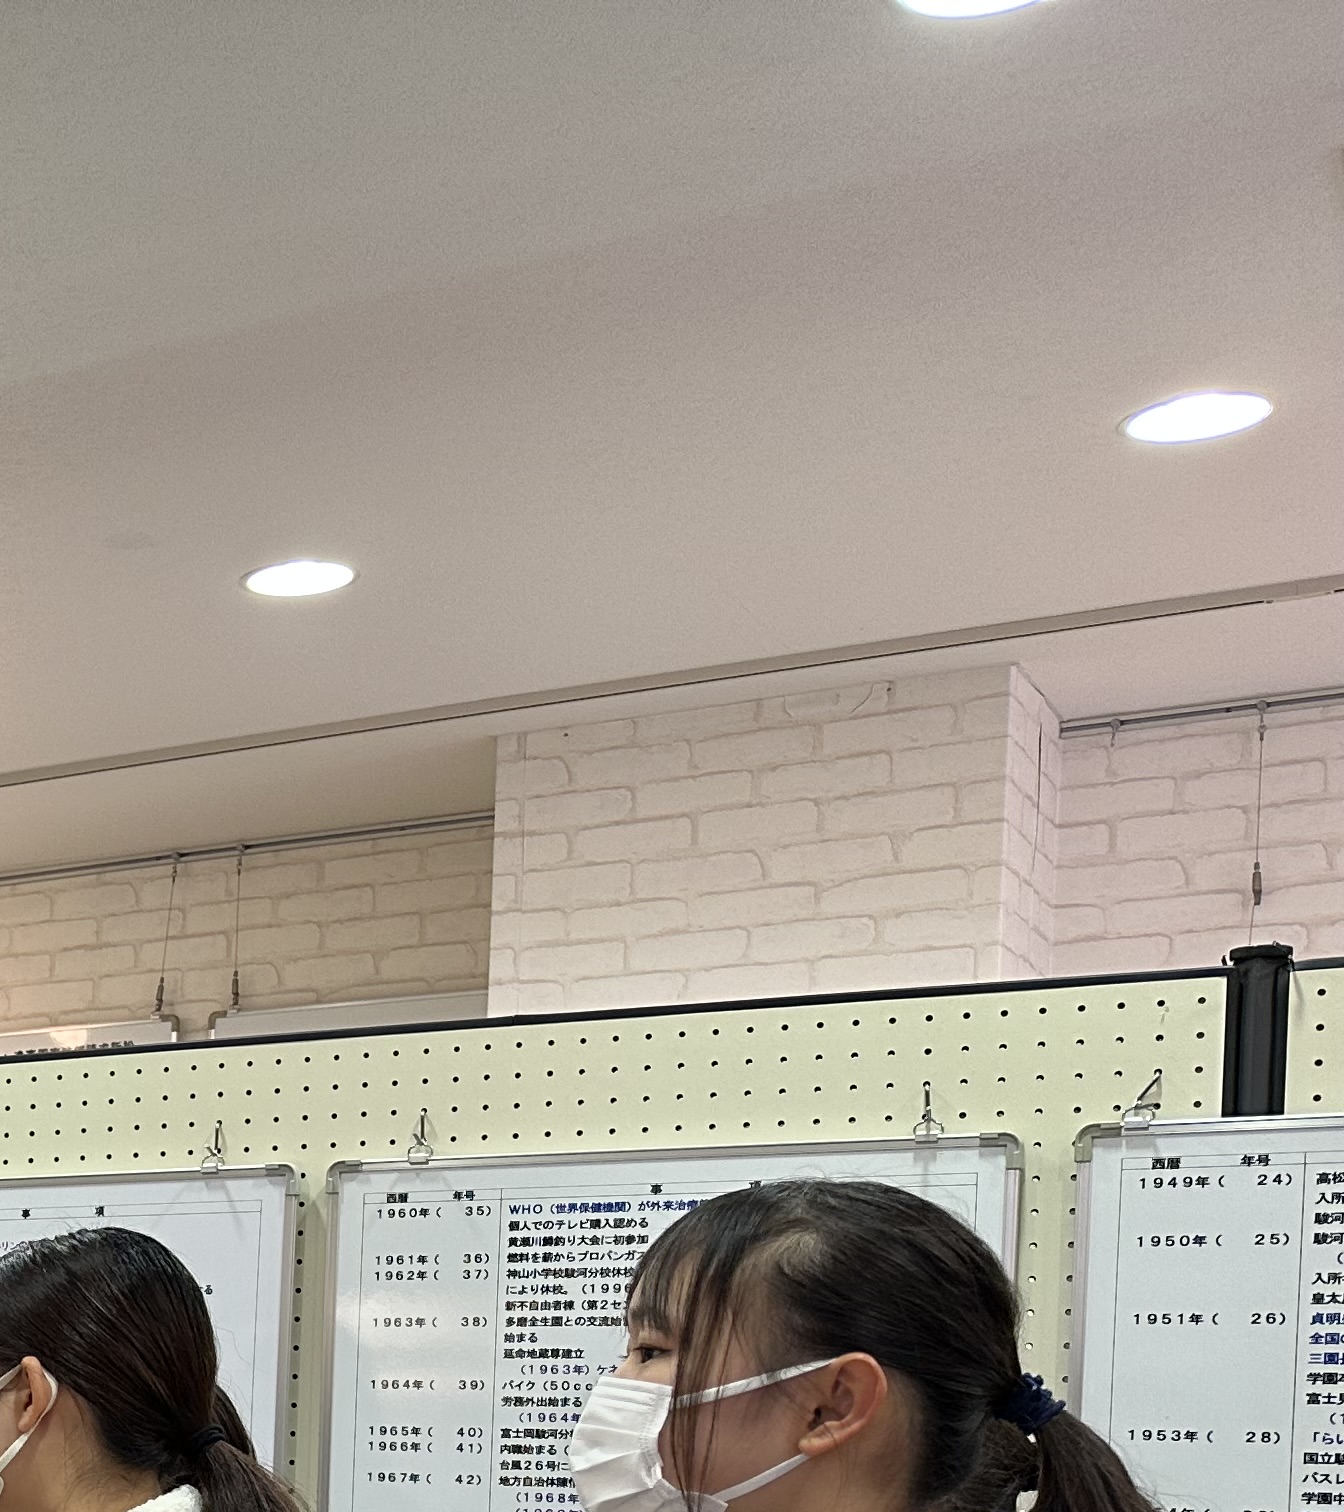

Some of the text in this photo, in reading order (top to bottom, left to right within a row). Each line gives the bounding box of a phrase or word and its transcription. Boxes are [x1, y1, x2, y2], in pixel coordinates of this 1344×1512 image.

[1151, 1154, 1271, 1170] 西暦 年号
[453, 1190, 475, 1201] 年号
[650, 1183, 663, 1195] 事
[504, 1332, 538, 1343] 始まる
